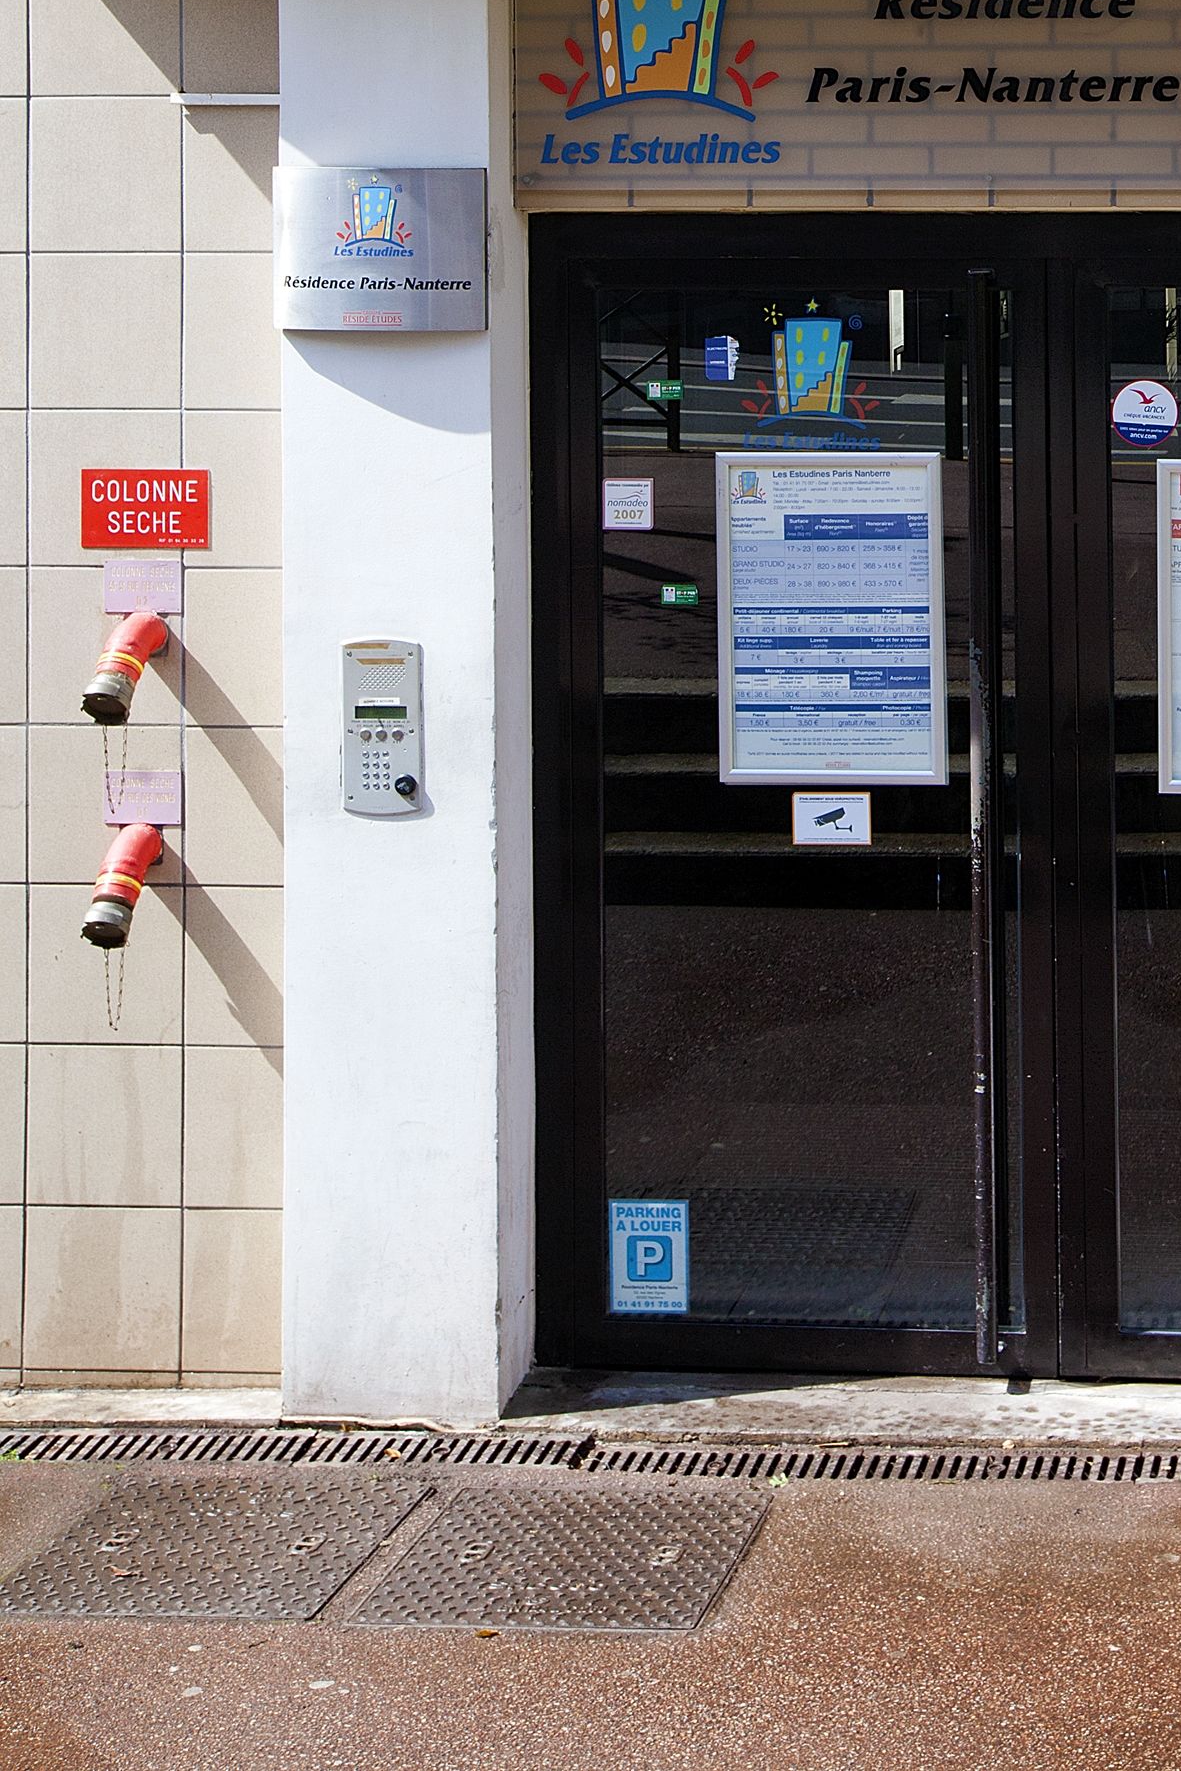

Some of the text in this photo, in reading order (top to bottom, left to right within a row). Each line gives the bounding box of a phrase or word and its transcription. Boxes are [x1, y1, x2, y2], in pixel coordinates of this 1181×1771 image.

[805, 66, 1181, 103] Paris-Nanterre
[540, 133, 781, 165] Les Estudines
[334, 246, 414, 258] Les Estudines
[284, 275, 472, 291] Résidence Paris-Nanterre
[1144, 406, 1166, 414] ancv
[772, 470, 788, 478] Les
[789, 470, 831, 478] Estudines
[91, 480, 198, 502] COLONNE
[607, 498, 648, 507] nomadeo
[614, 509, 644, 519] 2007
[108, 511, 181, 534] SECHE
[838, 719, 858, 727] gratuit
[616, 1207, 681, 1218] PARKING
[616, 1220, 682, 1231] A LOUER
